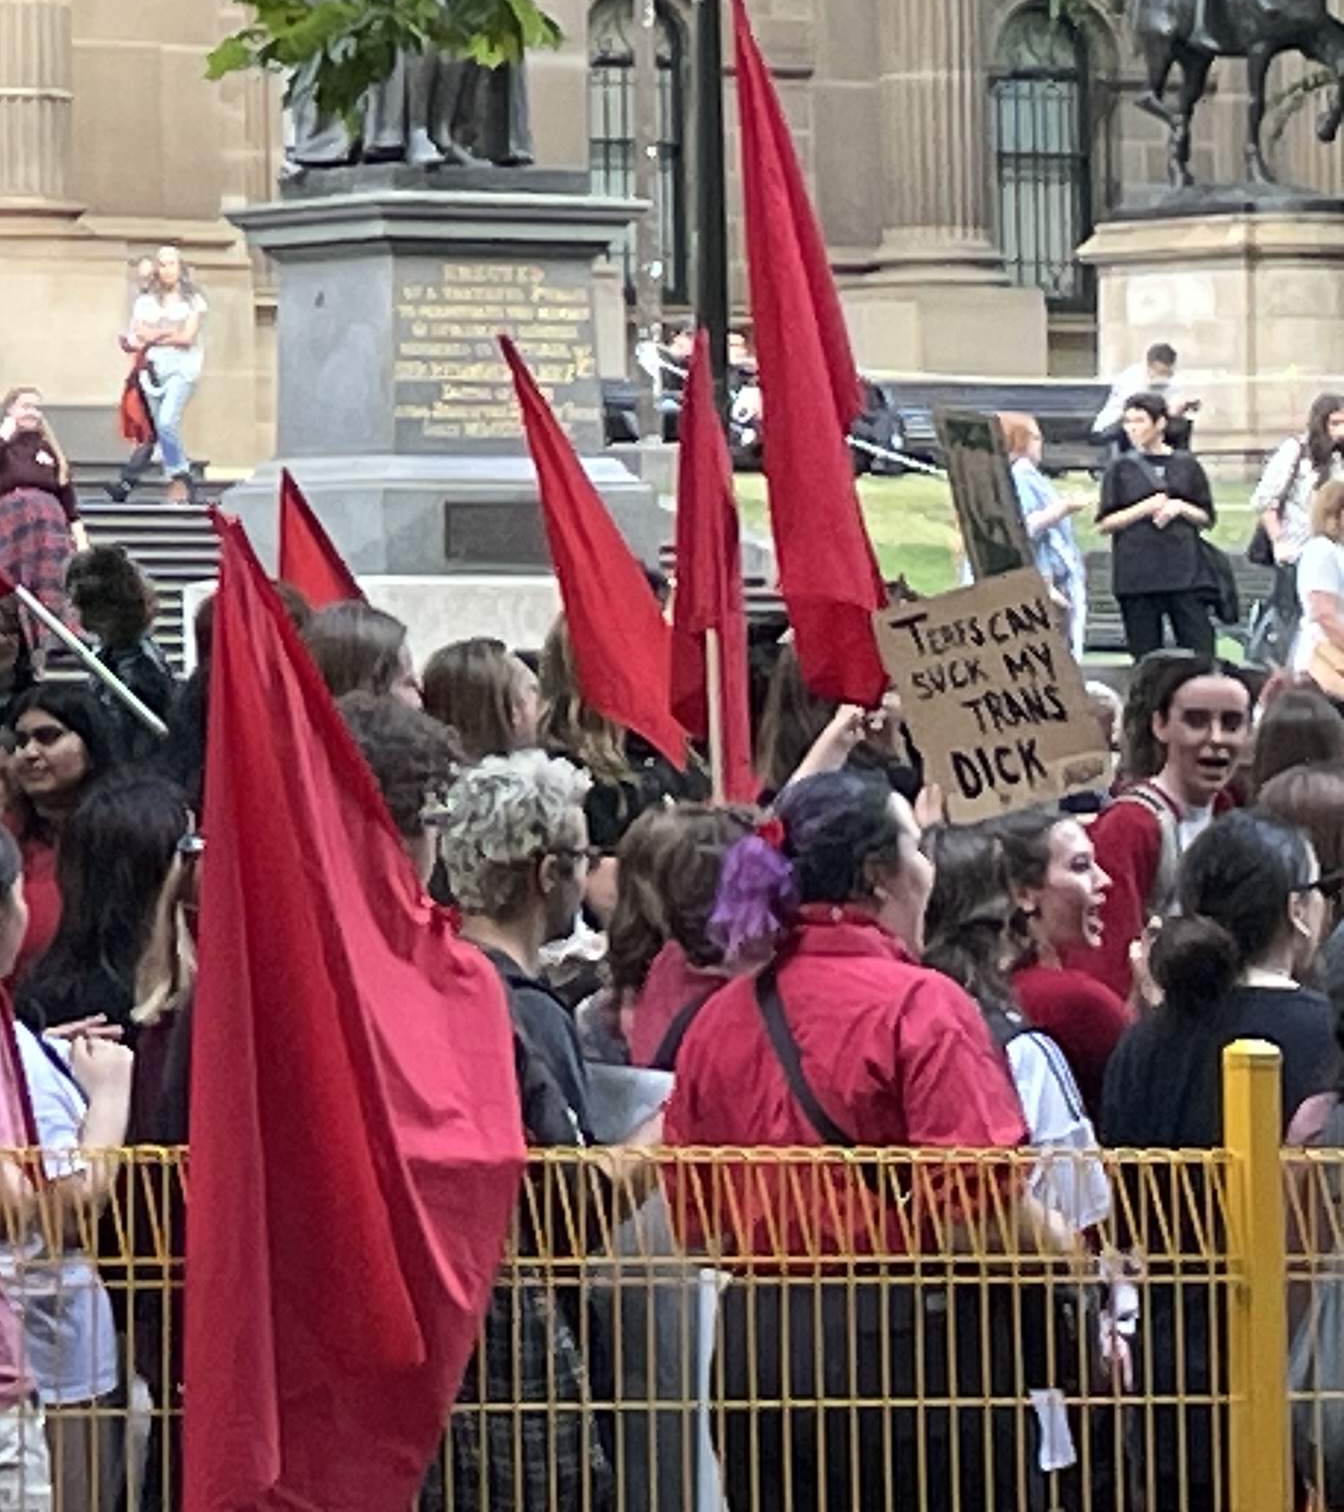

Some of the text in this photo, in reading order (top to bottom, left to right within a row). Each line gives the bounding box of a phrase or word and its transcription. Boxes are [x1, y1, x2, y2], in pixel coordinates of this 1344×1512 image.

[988, 598, 1051, 645] CAN
[1002, 641, 1059, 686] MY
[962, 687, 1068, 735] TRANS
[950, 738, 1049, 800] DICK
